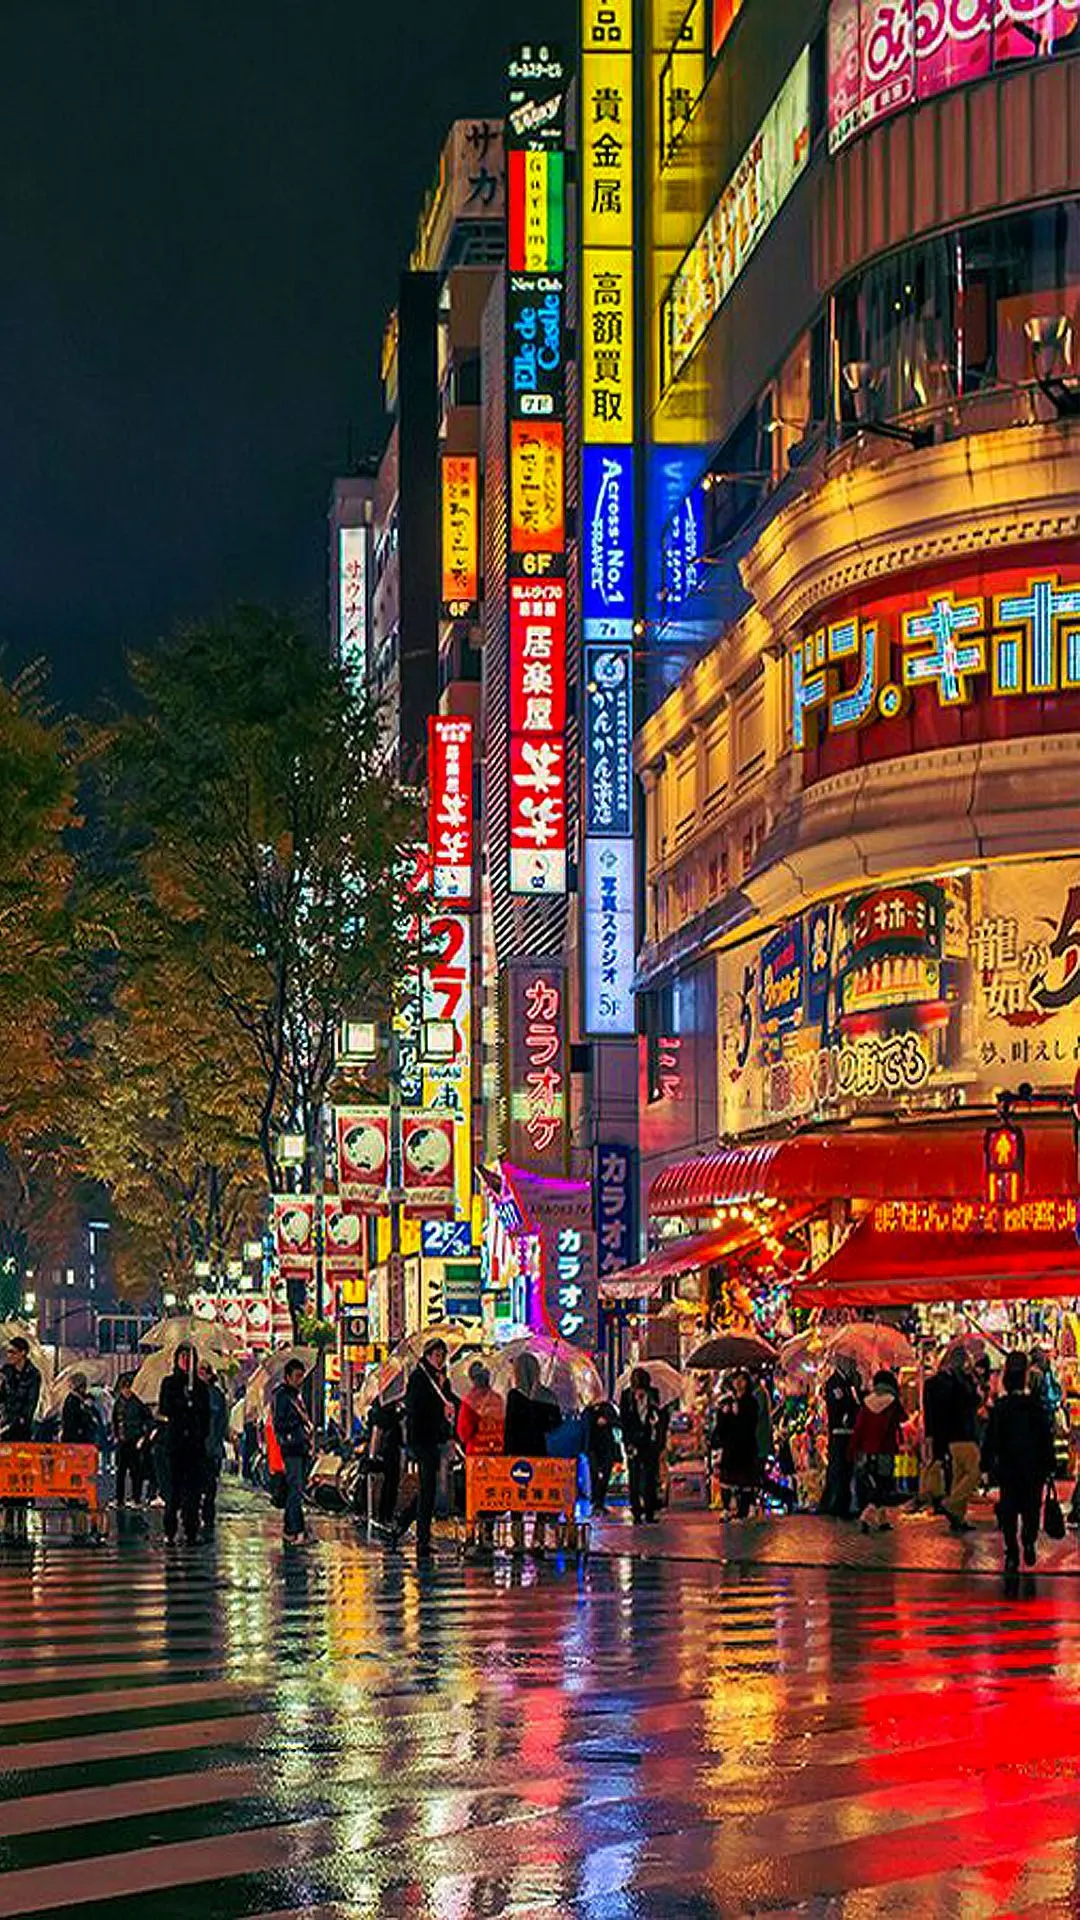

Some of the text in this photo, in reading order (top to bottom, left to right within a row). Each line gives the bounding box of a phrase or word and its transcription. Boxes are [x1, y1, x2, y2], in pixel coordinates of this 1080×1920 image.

[591, 88, 623, 214] 貴金属
[512, 277, 534, 291] New
[514, 307, 537, 340] de
[538, 294, 560, 370] Castle
[591, 272, 624, 422] 高額買取
[522, 554, 552, 575] 6F
[600, 876, 619, 985] 写真スタジオ
[524, 979, 561, 1150] カラオケ
[601, 1152, 627, 1272] カラオケ
[557, 1228, 585, 1337] カラオケ
